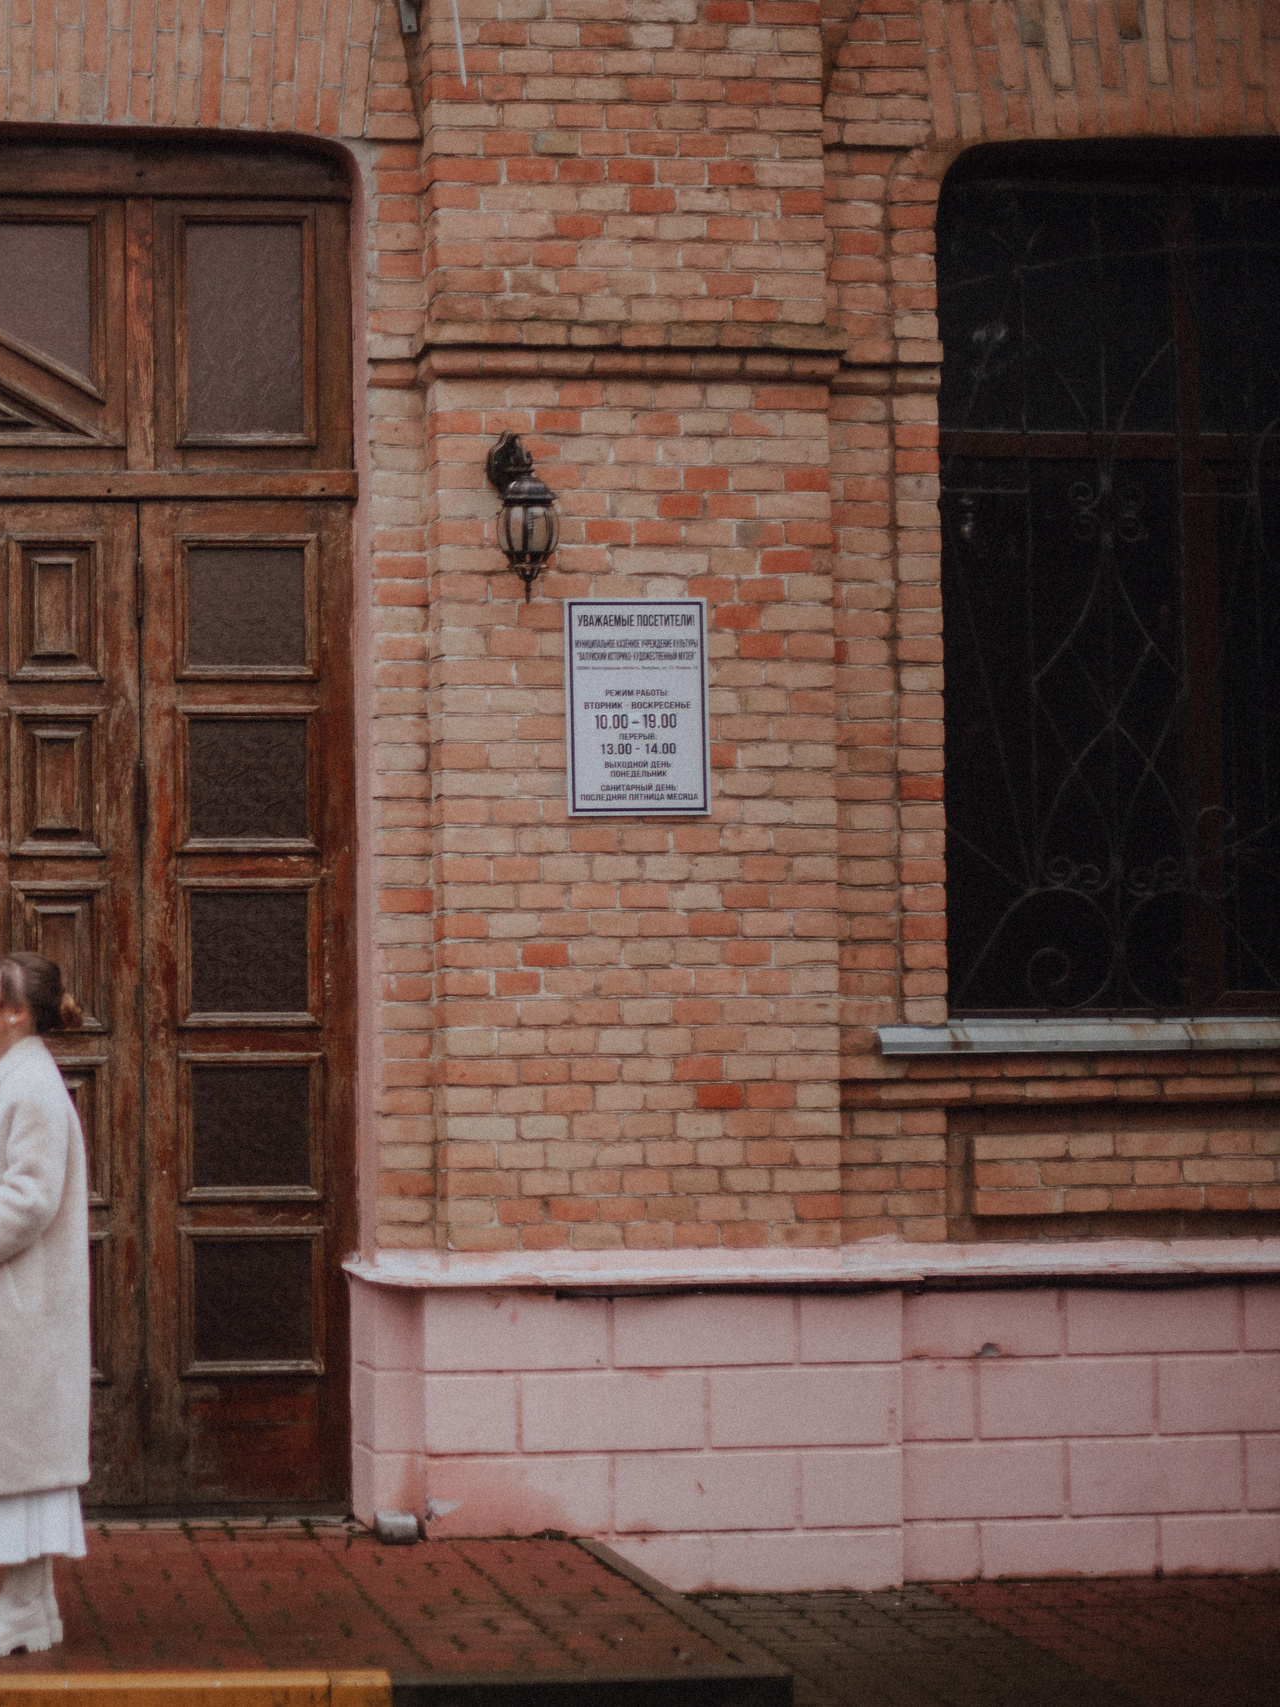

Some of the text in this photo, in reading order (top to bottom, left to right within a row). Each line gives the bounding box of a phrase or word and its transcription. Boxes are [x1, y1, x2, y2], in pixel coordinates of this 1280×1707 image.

[577, 613, 695, 627] УВАЖАЕМЫЕ ПОСЕТИТЕЛИ!
[641, 639, 672, 649] УЧРЕЖДЕНИЕ
[673, 639, 699, 648] КУЛЬТУРЫ
[605, 689, 670, 697] РЕЖИМ РАБОТЫ:
[584, 701, 623, 710] ВТОРНИК
[631, 701, 691, 709] ВОСКРЕСЕНЬЕ
[595, 714, 628, 729] 10.00
[643, 713, 677, 729] 19.00
[619, 732, 657, 740] ПЕРЕРЫВ:
[601, 743, 632, 755] 13.00
[644, 742, 677, 755] 14.00
[604, 760, 649, 769] ВЫХОДНОЙ
[610, 770, 668, 778] ПОНЕДЕЛЬНИК
[601, 783, 653, 792] САНИТАРНЫЙ
[580, 793, 699, 802] ПОСЛЕДНЯЯ ПЯТНИЦА МЕСЯЦА
